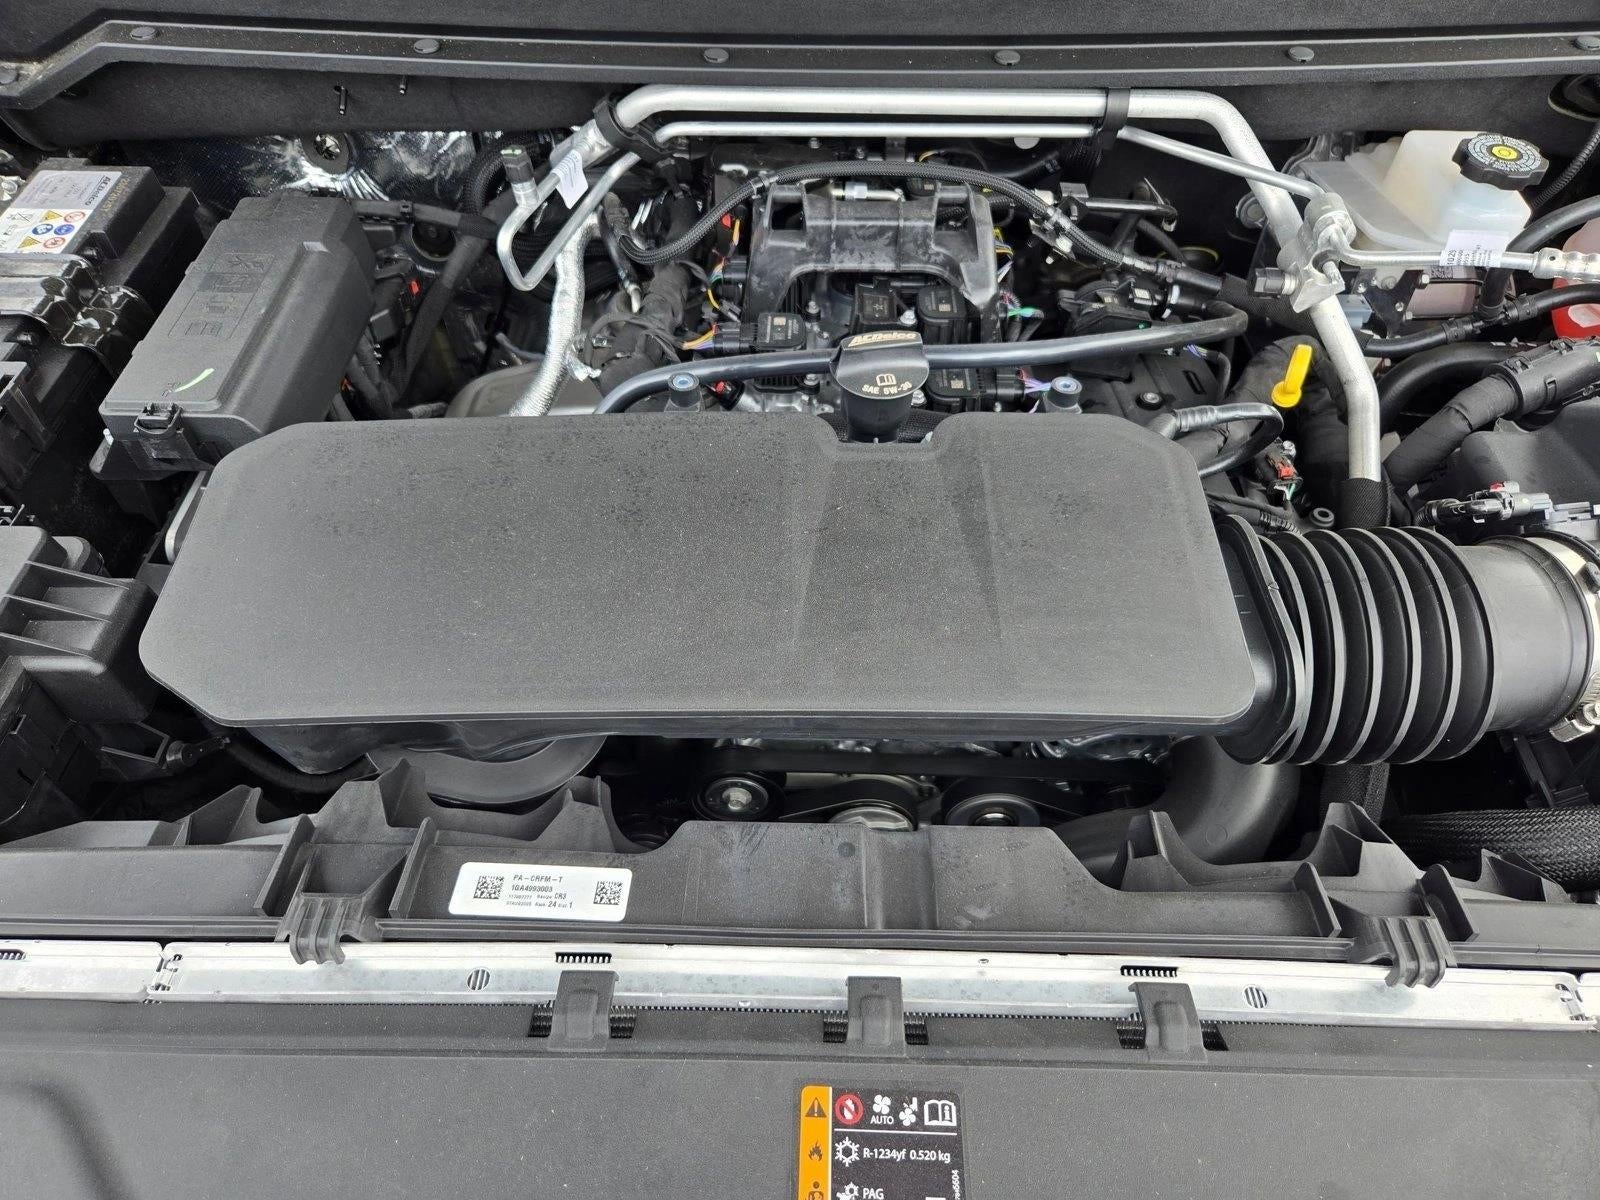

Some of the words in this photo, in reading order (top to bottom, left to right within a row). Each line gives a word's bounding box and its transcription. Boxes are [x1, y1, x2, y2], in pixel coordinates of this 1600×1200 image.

[848, 332, 917, 347] ACDelco
[862, 383, 880, 395] SAE
[870, 1115, 894, 1124] AUTO
[863, 1147, 906, 1161] R-1234yf
[910, 1151, 937, 1161] 0.520
[938, 1151, 951, 1164] kg
[863, 1188, 885, 1200] PAG
